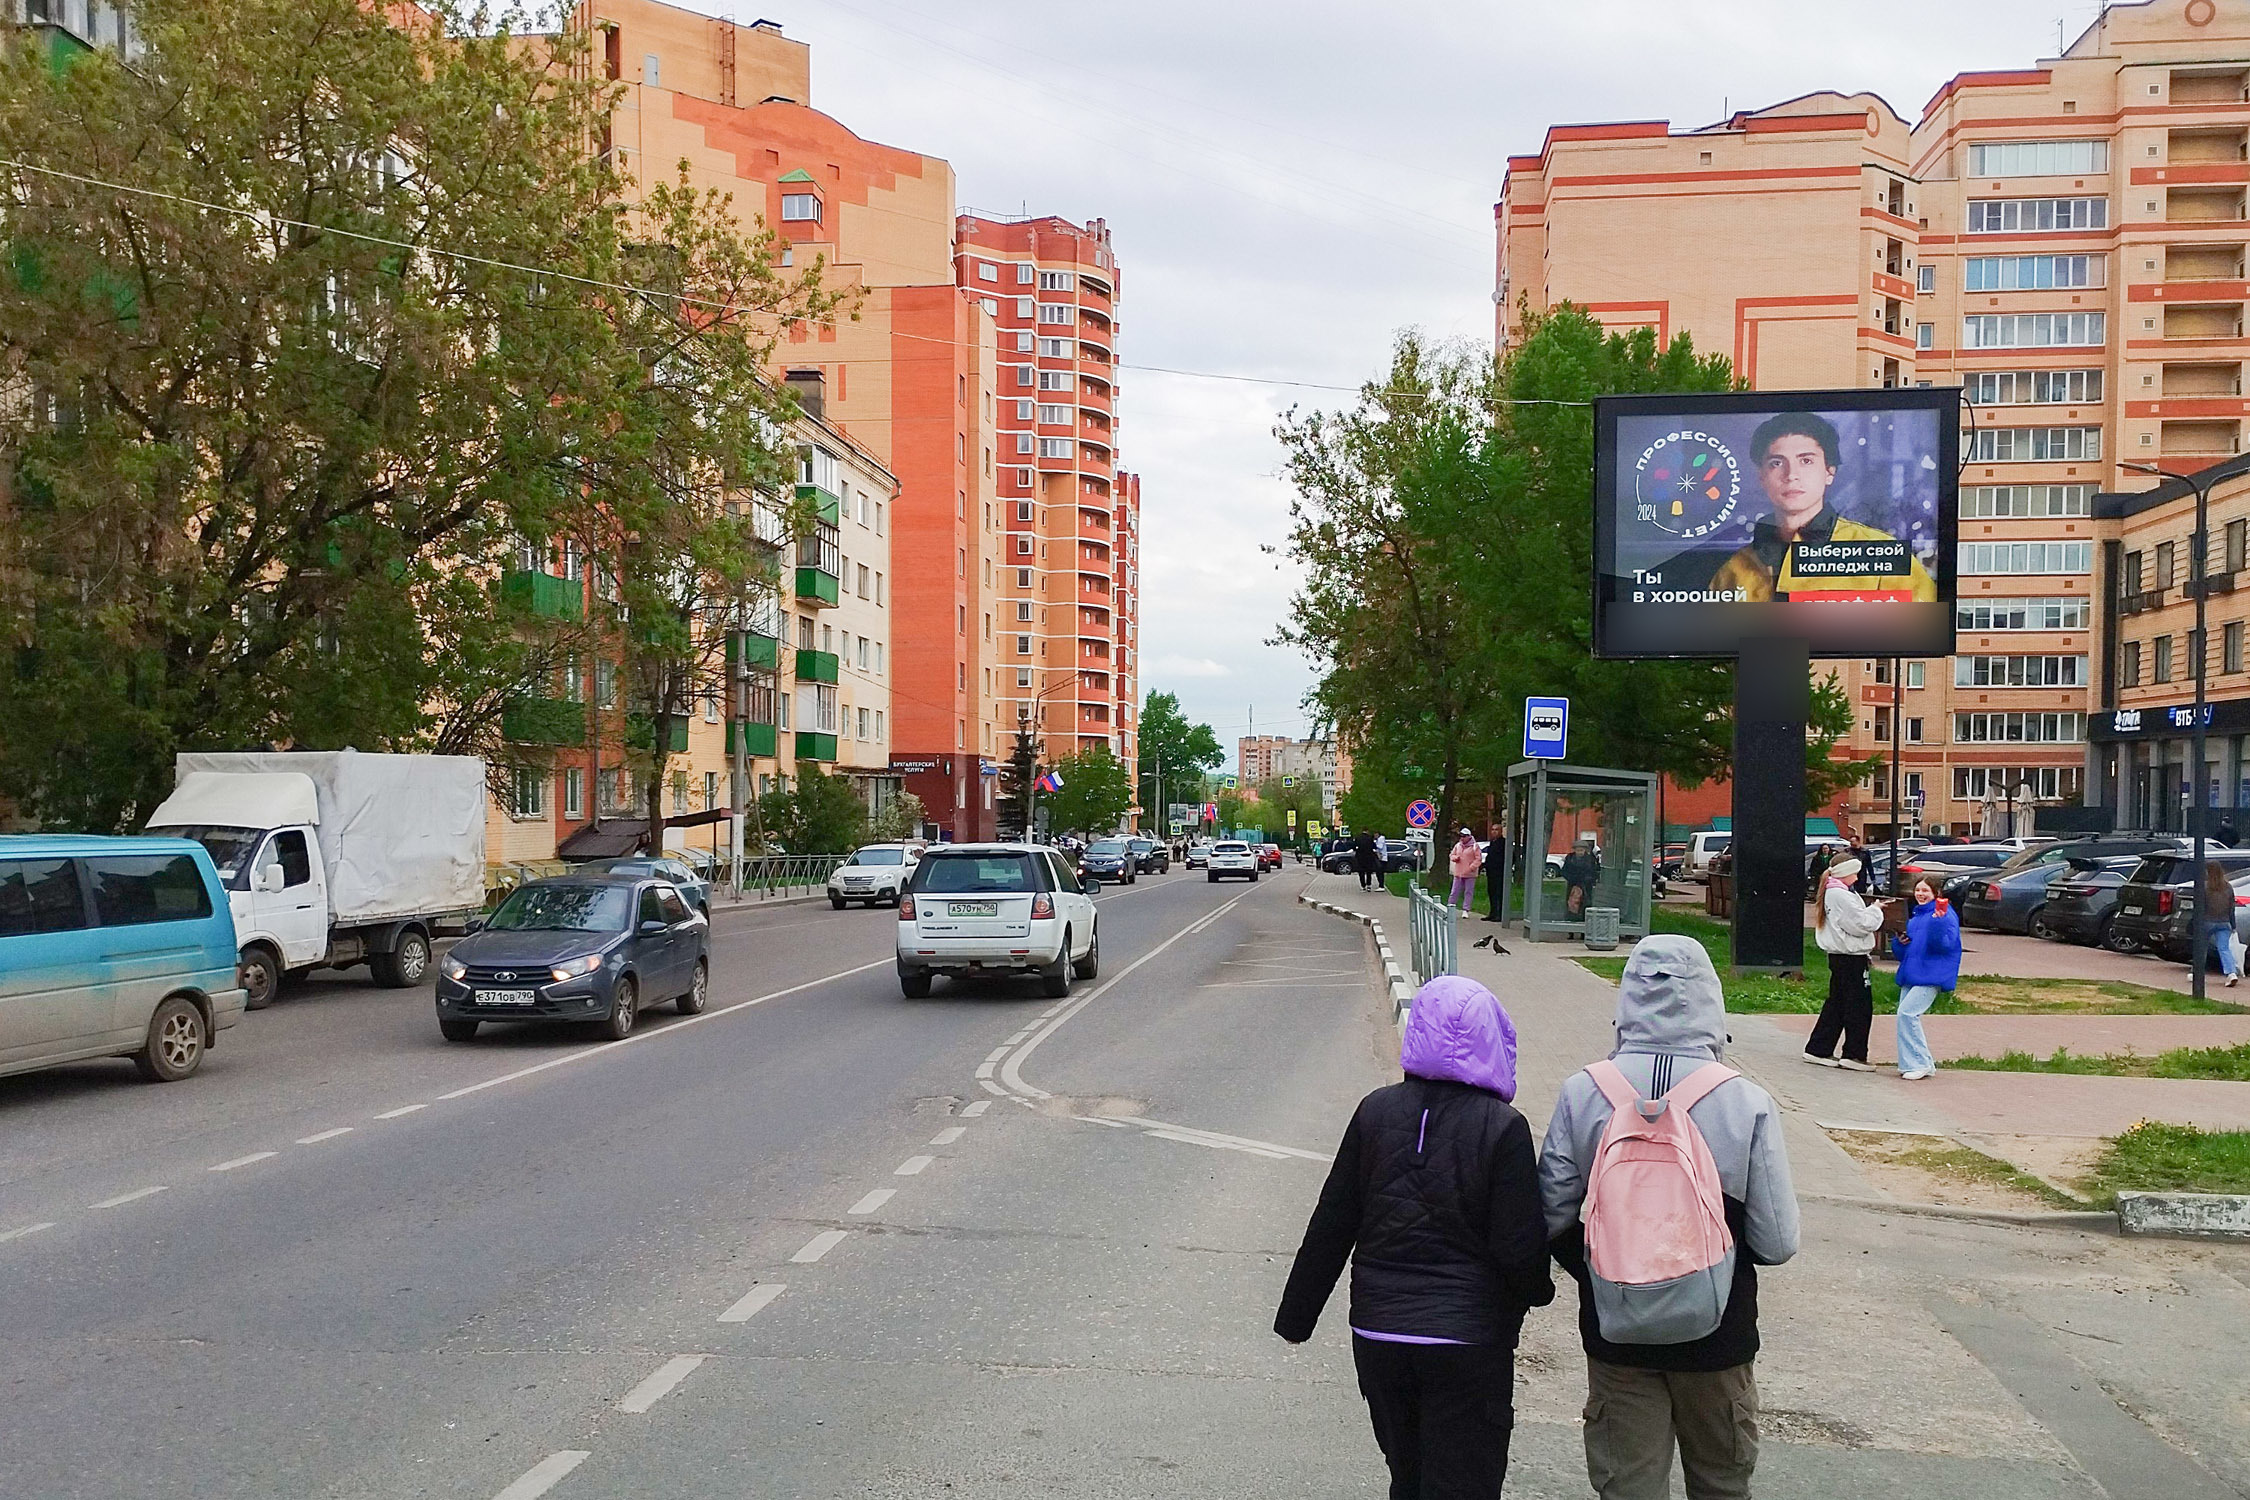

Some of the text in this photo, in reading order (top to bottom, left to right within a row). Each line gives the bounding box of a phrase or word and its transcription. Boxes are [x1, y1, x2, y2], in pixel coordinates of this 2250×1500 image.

[1635, 431, 1741, 538] ПРОФЕССИОНАЛИТЕТ
[1637, 504, 1657, 521] 2024
[1798, 543, 1904, 559] Выбери свой
[1798, 562, 1893, 574] колледж на
[1632, 569, 1662, 585] Ты
[1633, 586, 1748, 603] в хорошей
[2175, 709, 2193, 727] ВТБ
